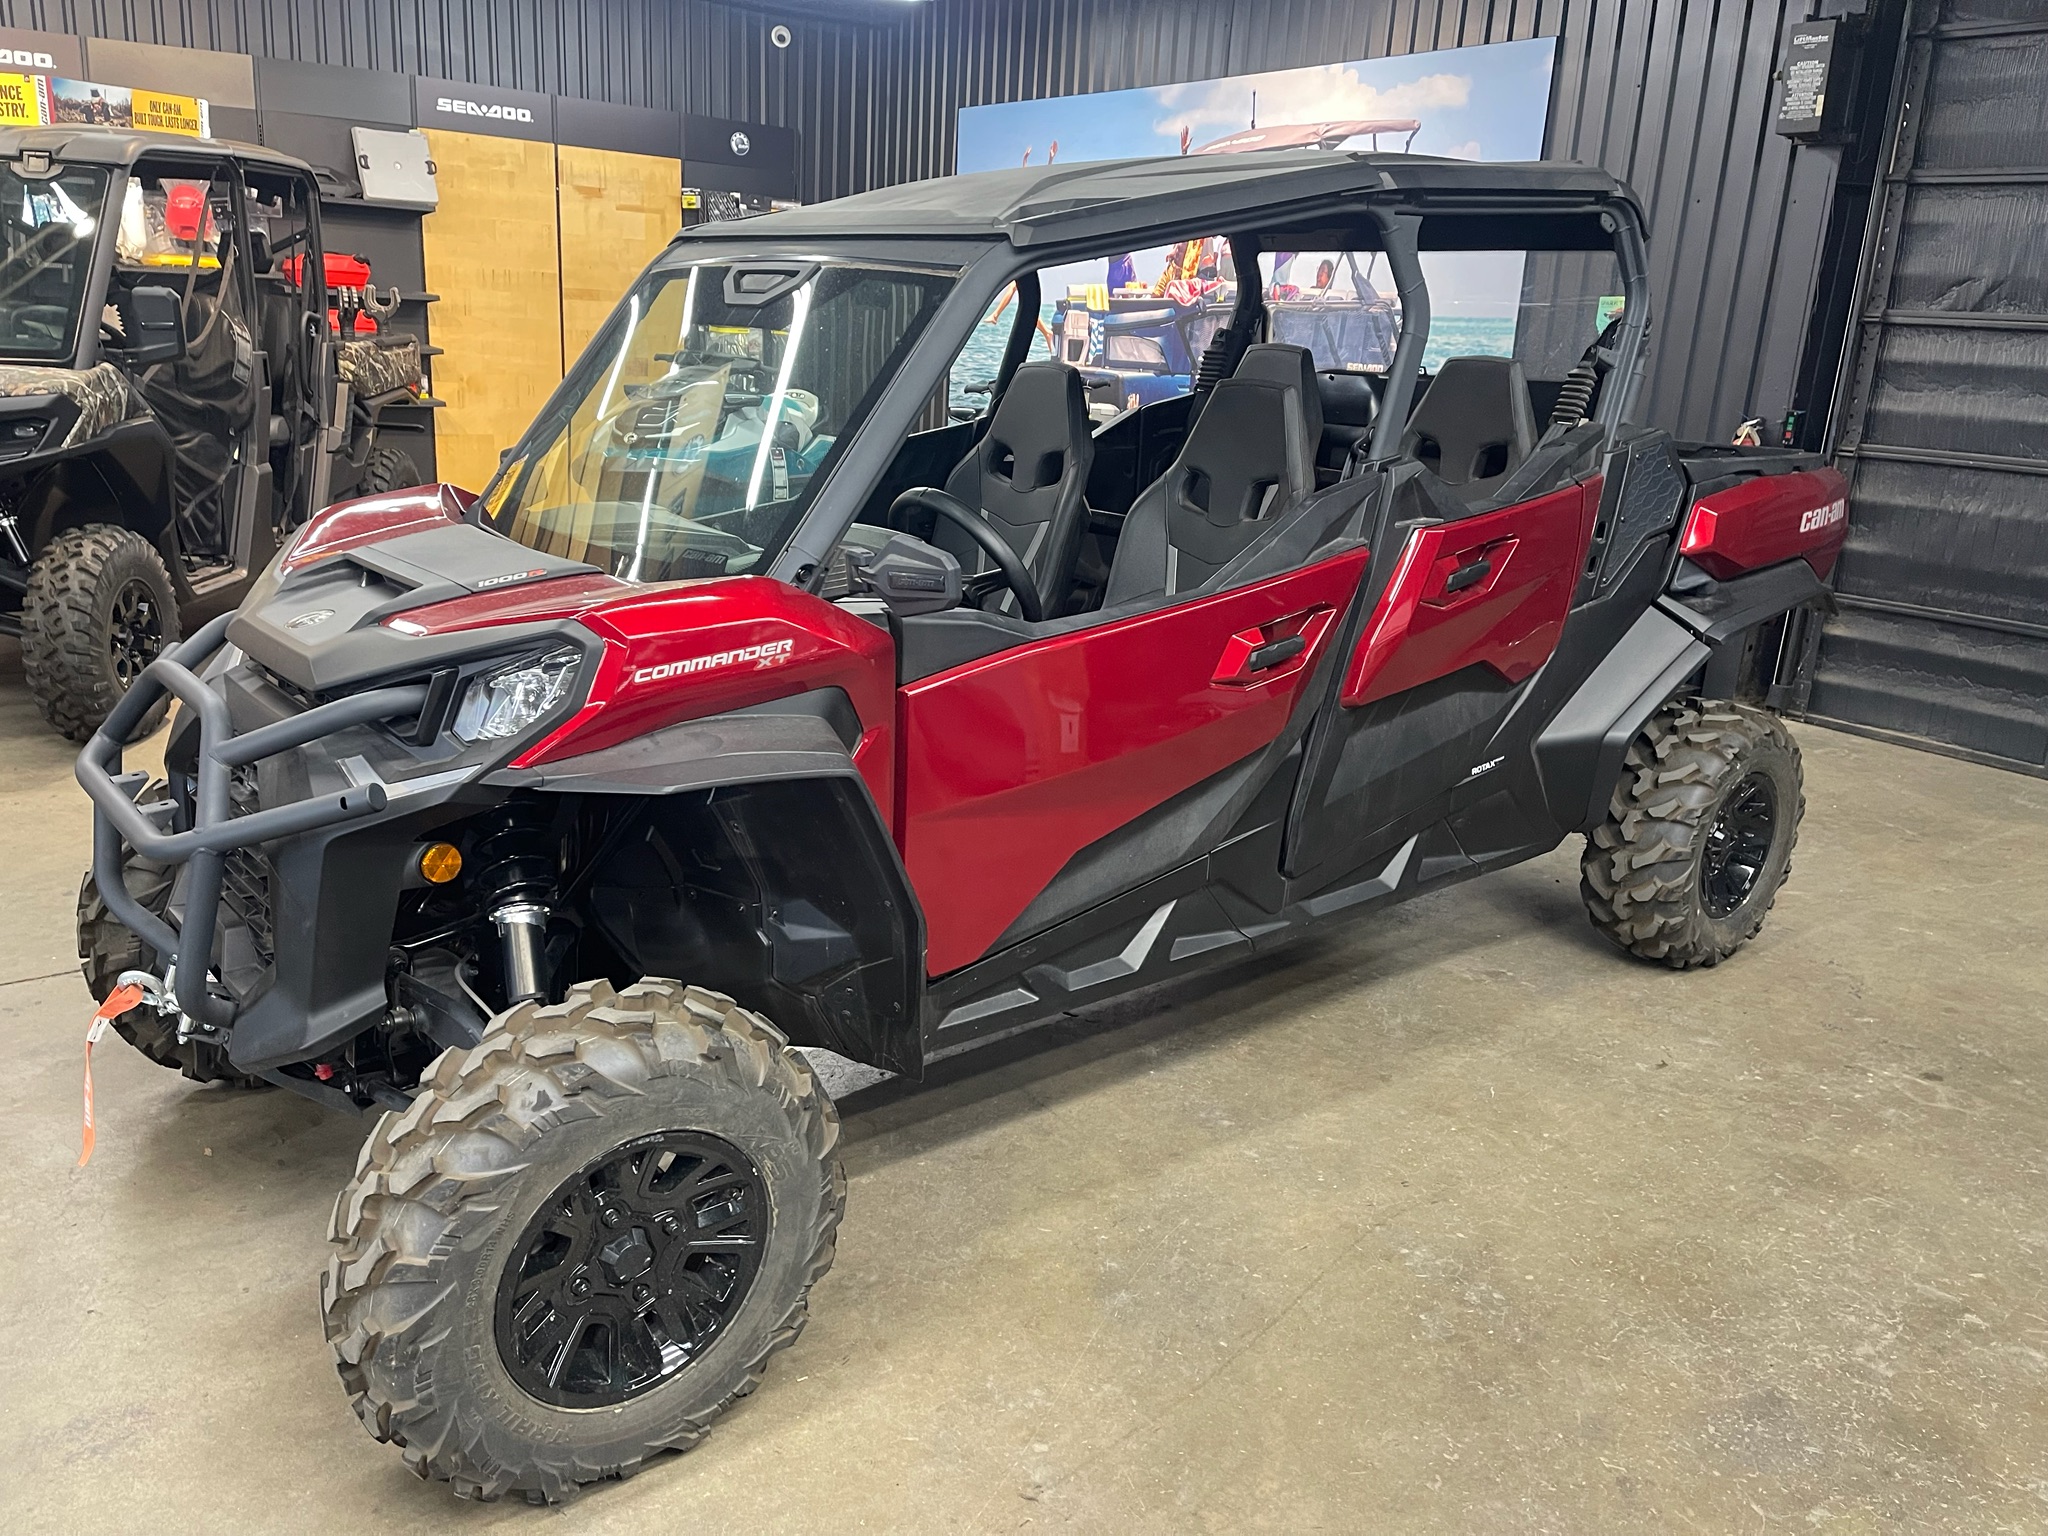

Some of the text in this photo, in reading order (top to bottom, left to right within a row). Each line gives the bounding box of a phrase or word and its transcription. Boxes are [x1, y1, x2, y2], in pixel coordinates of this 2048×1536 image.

[633, 638, 794, 684] COMMANDER
[756, 652, 791, 669] XT
[1471, 755, 1505, 776] ROTAX
